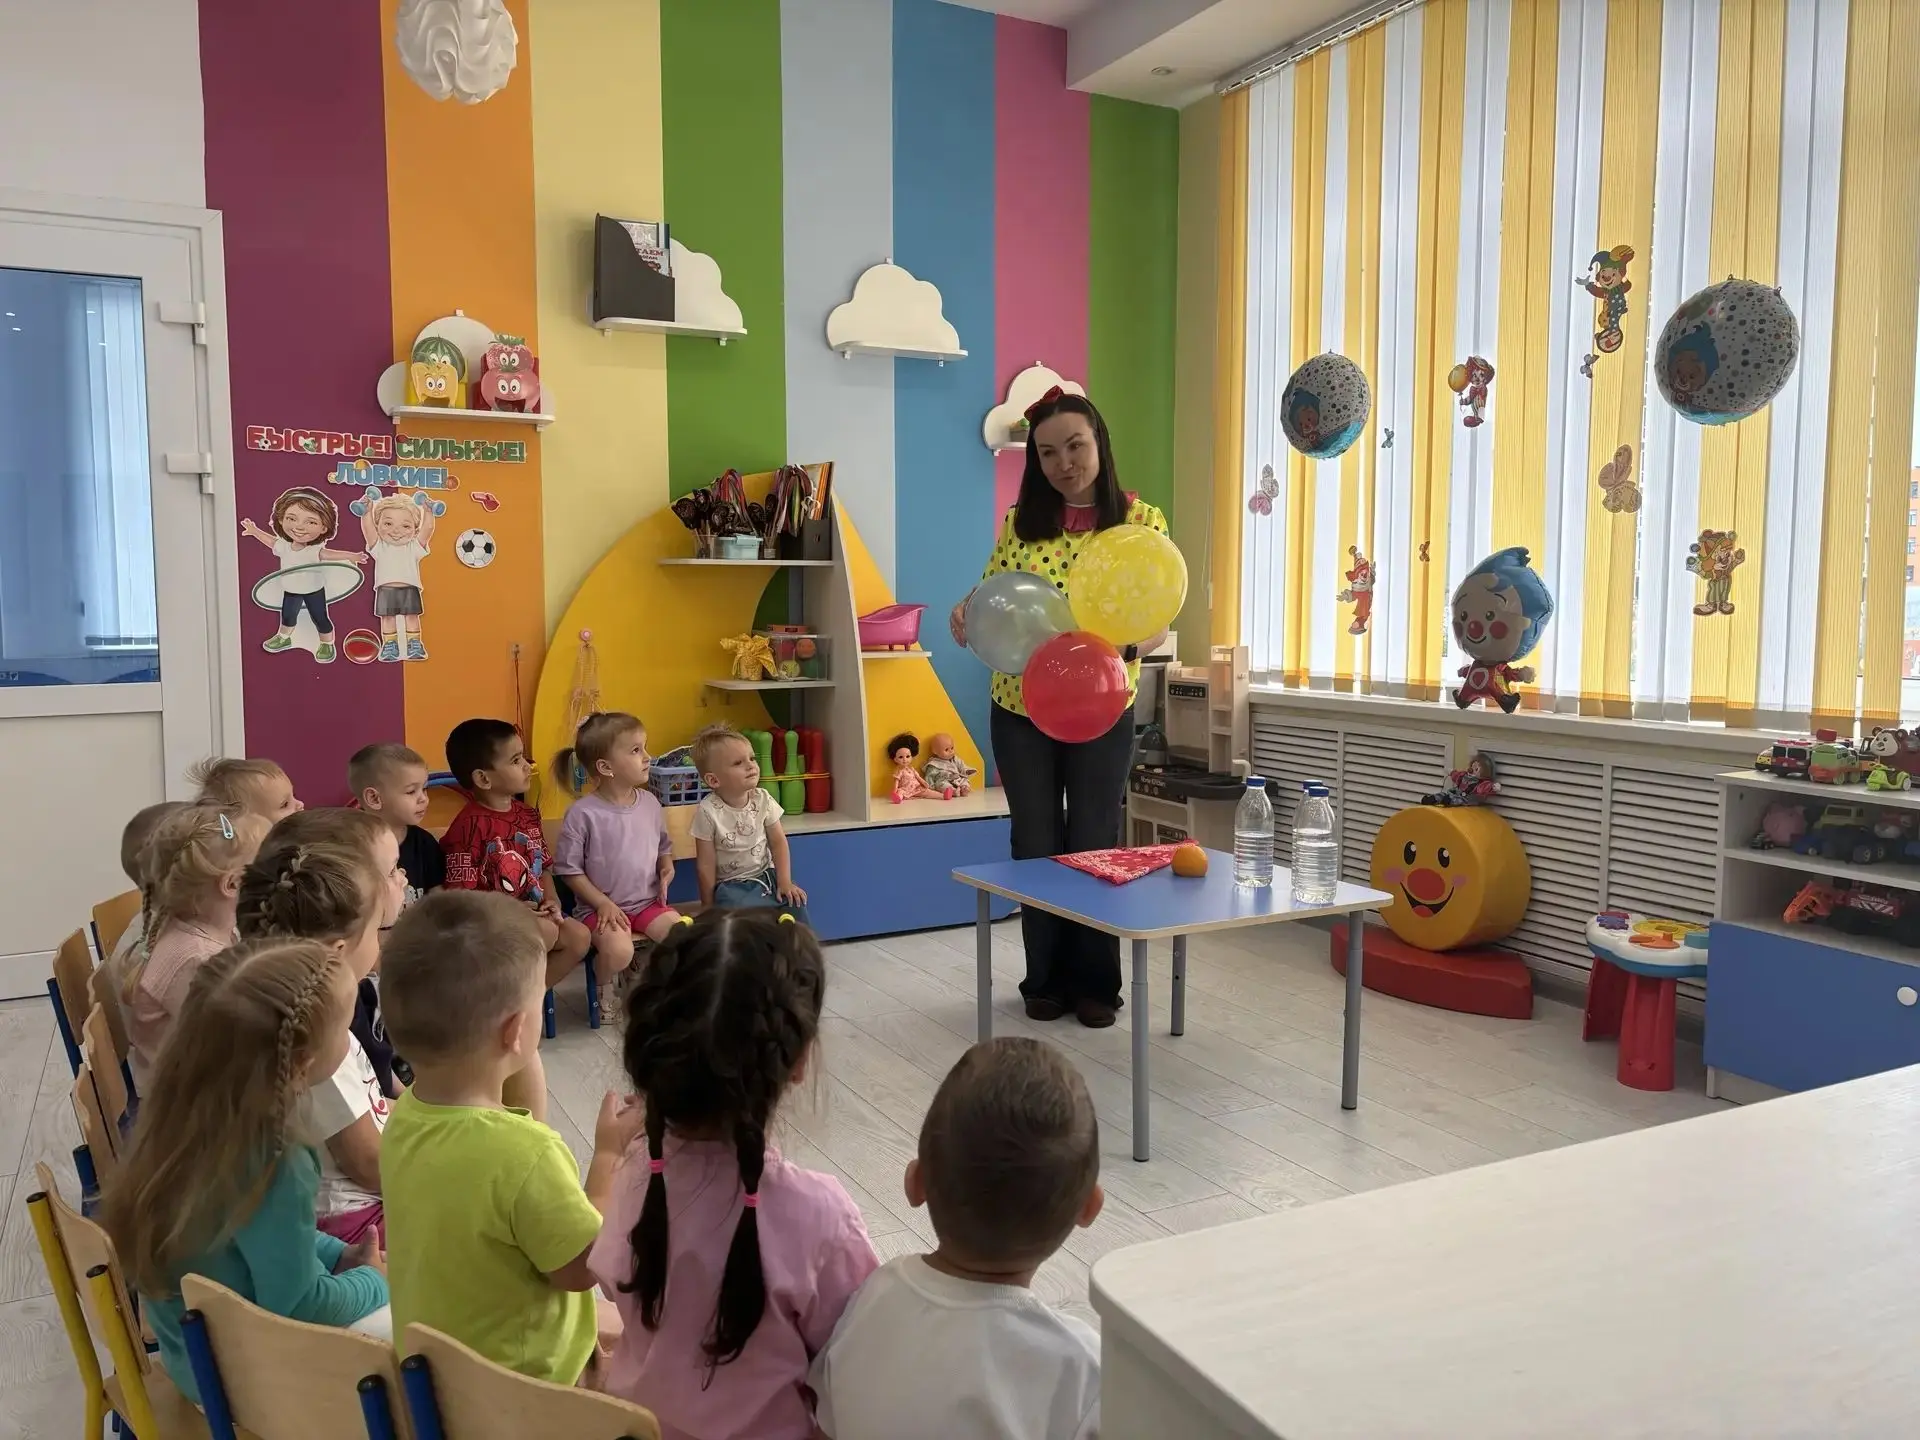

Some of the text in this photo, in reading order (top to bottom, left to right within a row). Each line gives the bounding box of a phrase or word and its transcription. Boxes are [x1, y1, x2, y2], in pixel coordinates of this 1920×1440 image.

[635, 248, 664, 257] ТАЕМ
[247, 425, 526, 463] БЫСТРЫЕ! СИЛЬНЫЕ!
[335, 460, 449, 490] ЛОВКИЕ!
[446, 852, 472, 867] HE
[446, 867, 478, 882] AZIN
